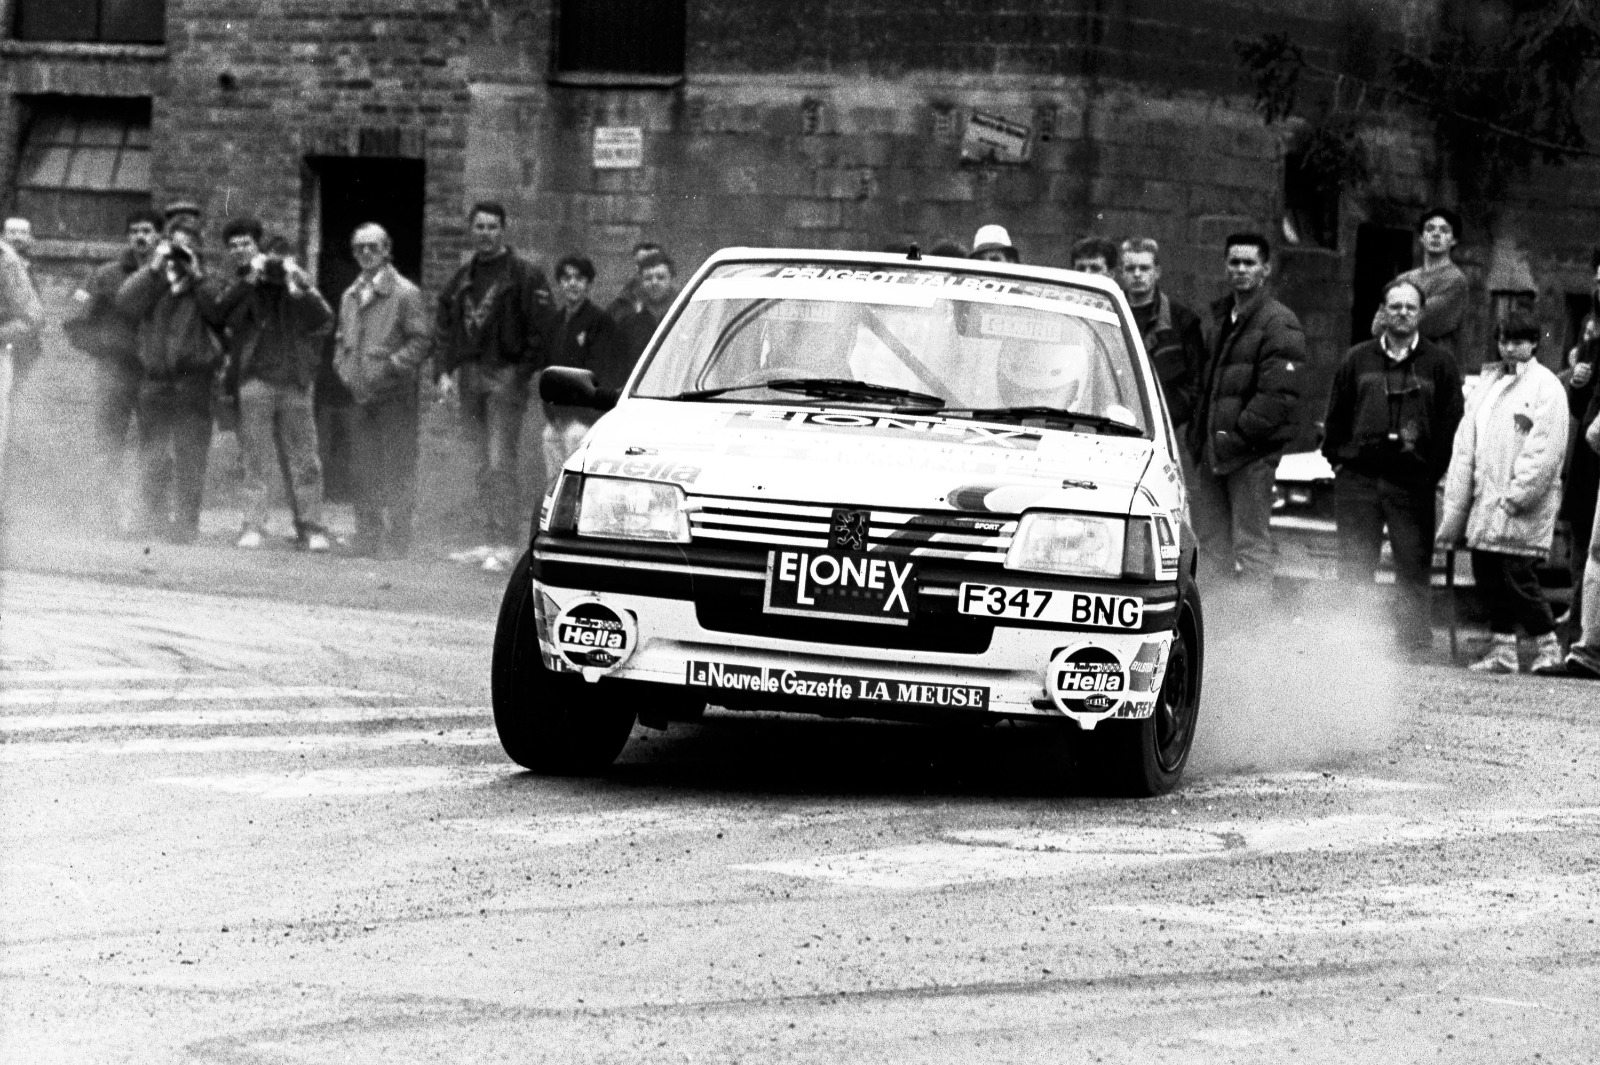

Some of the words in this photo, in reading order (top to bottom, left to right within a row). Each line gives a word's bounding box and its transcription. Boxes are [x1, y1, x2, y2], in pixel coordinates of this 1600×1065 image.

[776, 267, 908, 284] PEUGEOT
[912, 274, 1019, 295] TALBOT
[974, 522, 1000, 531] SPORT
[779, 551, 914, 613] ELONEX
[963, 583, 1053, 618] F347
[1071, 593, 1139, 628] BNG
[563, 625, 623, 648] Hella
[689, 660, 706, 685] La
[707, 661, 778, 693] Nouvelle
[780, 669, 853, 700] Gazette
[858, 679, 891, 700] LA
[897, 683, 983, 708] MEUSE
[1062, 672, 1121, 692] Hella
